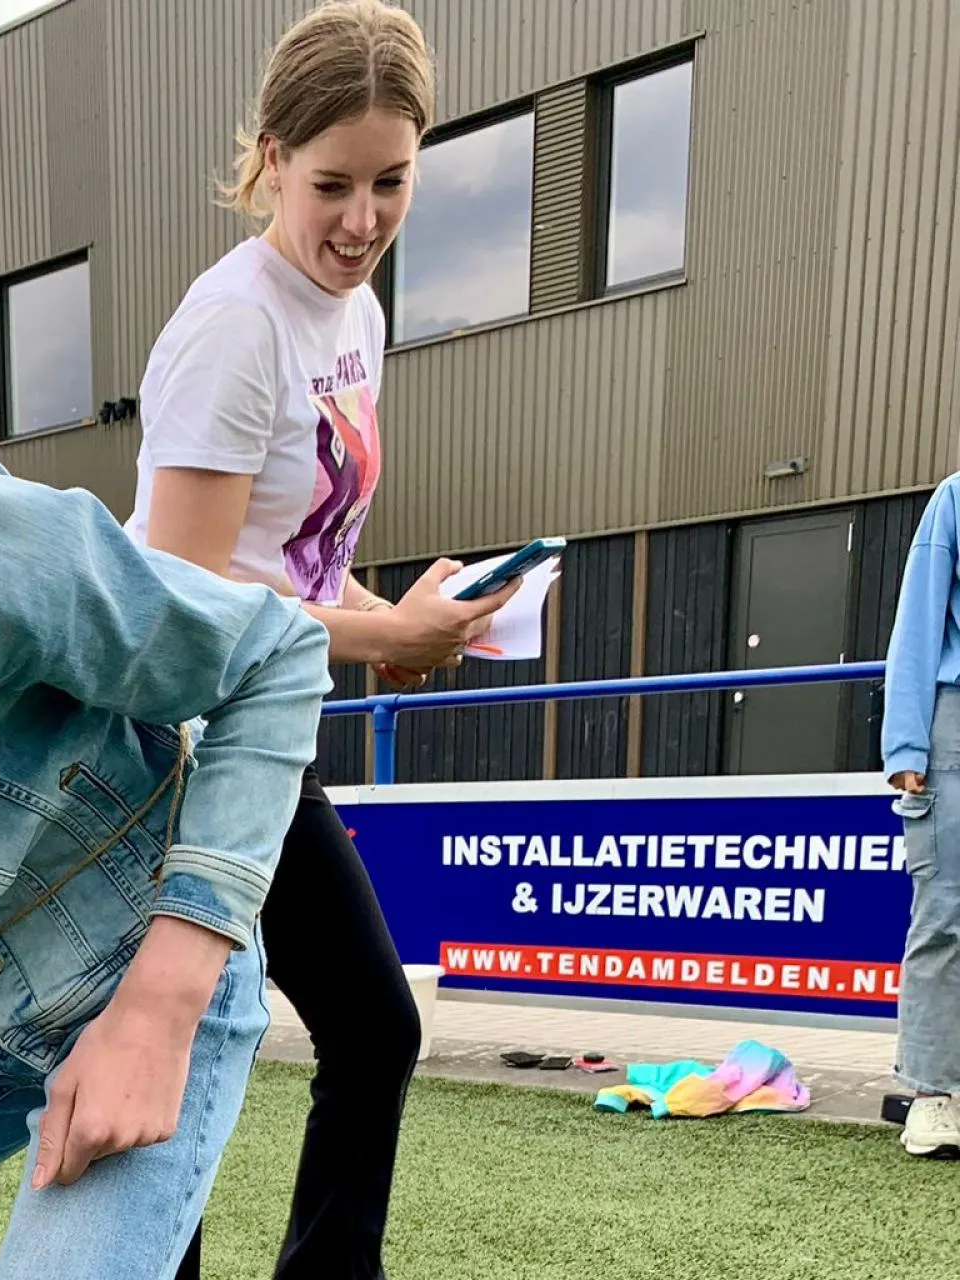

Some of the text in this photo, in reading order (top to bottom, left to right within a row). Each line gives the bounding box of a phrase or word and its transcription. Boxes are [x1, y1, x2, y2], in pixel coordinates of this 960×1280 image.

[336, 349, 367, 389] PARIS
[511, 882, 825, 923] & IJZERWAREN
[447, 948, 901, 995] WWW.TENDAMDELDEN.NL
